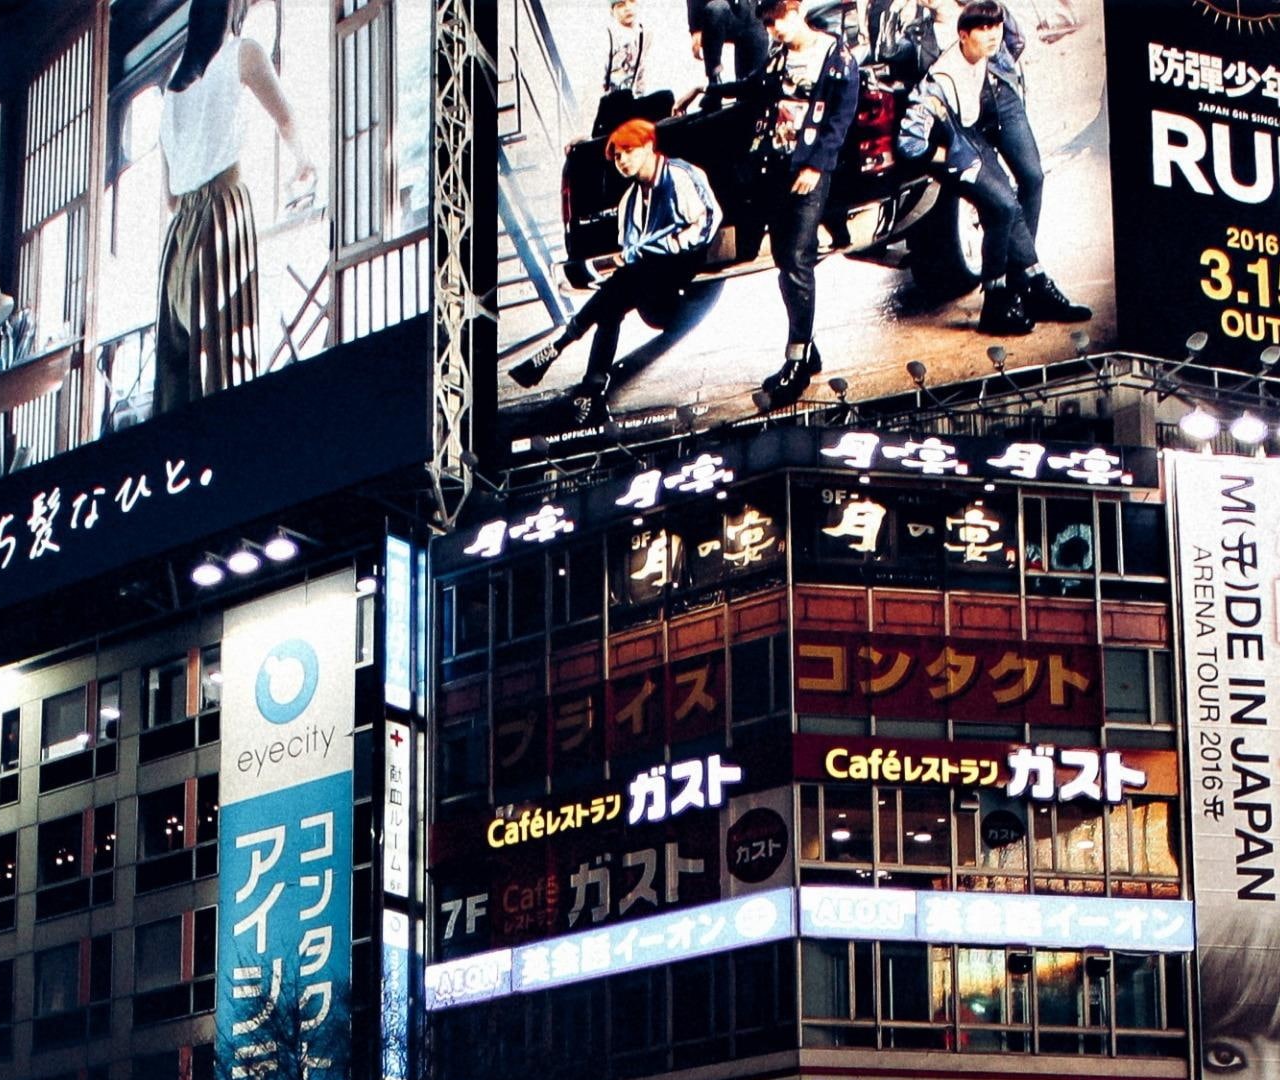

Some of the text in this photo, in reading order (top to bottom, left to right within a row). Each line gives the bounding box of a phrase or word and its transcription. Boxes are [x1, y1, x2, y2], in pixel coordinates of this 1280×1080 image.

[1198, 101, 1230, 116] JAPAN
[1225, 228, 1280, 256] 2016
[1192, 545, 1217, 651] ARENA
[798, 644, 1091, 706] コンタクト
[1196, 652, 1221, 722] TOUR
[1228, 679, 1267, 727] IN
[496, 663, 718, 768] プライス
[236, 724, 336, 777] eyecity
[1006, 742, 1147, 802] ガスト
[1200, 731, 1223, 791] 2016
[628, 754, 742, 826] ガスト
[1230, 737, 1276, 901] JAPAN
[735, 840, 782, 865] ガスト
[569, 842, 705, 928] ガスト
[440, 893, 489, 940] 7F
